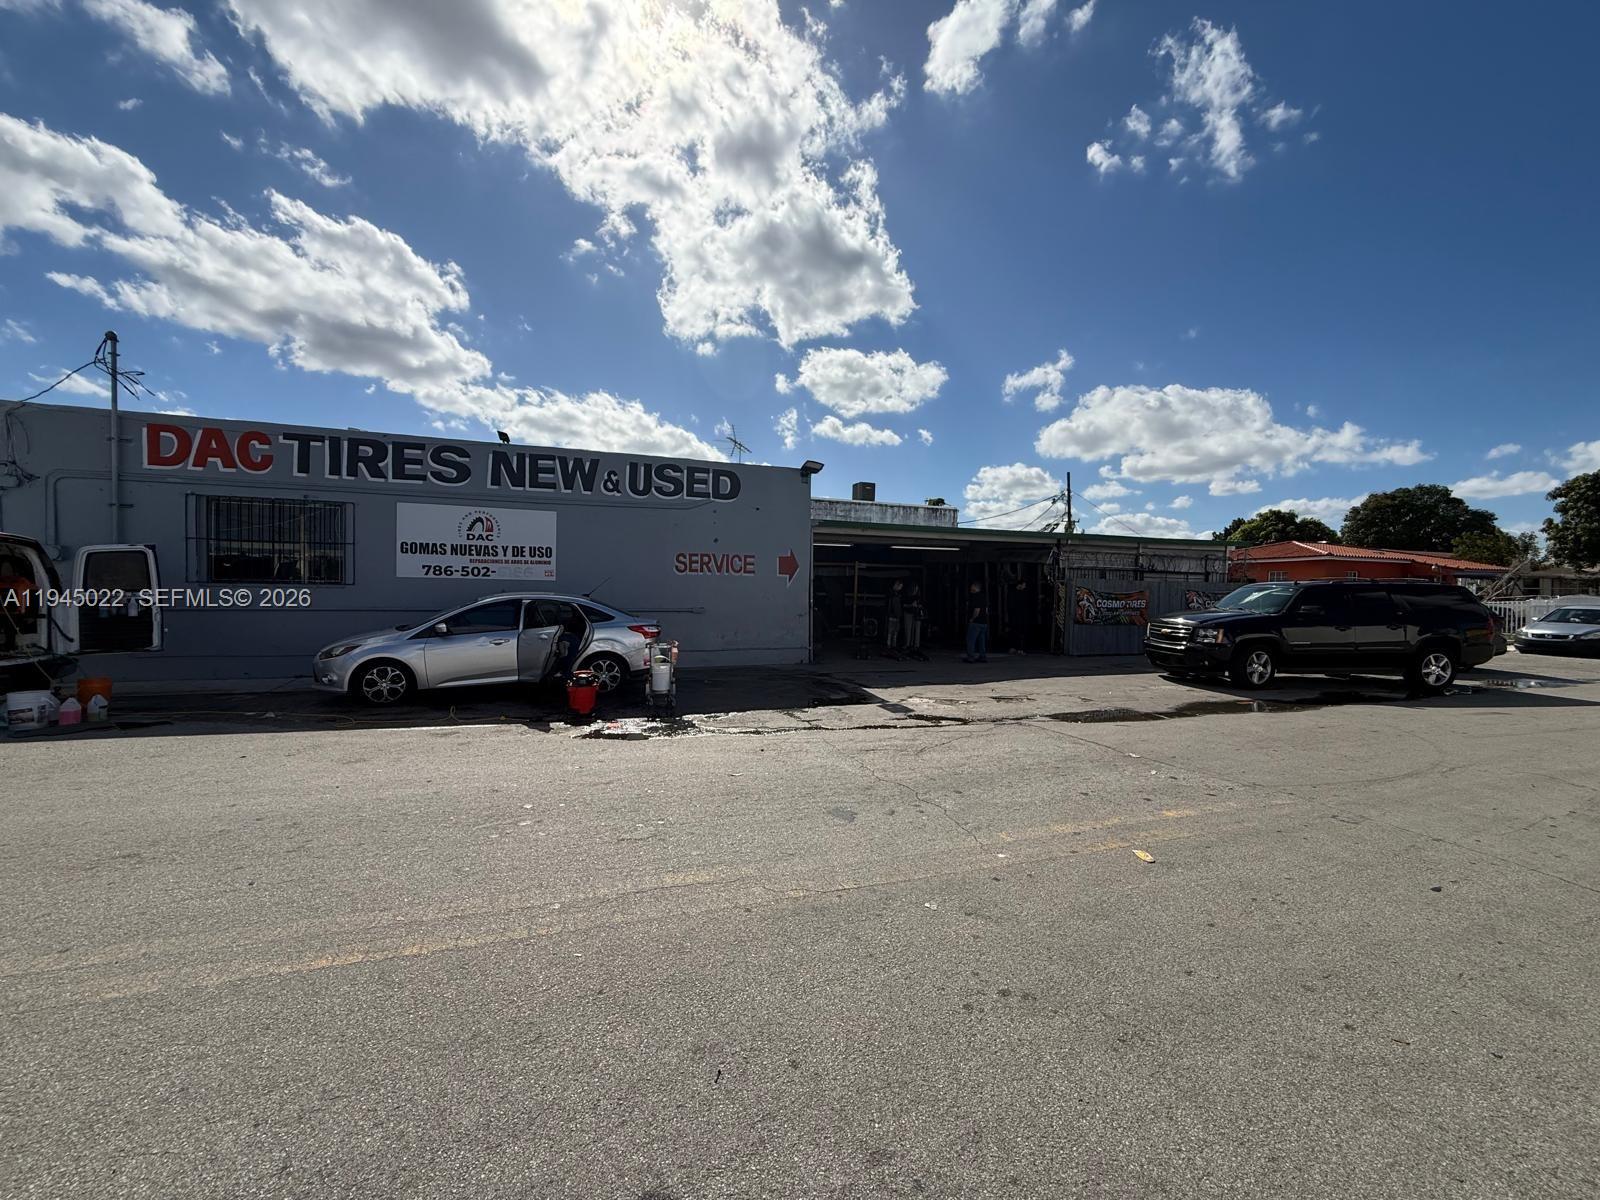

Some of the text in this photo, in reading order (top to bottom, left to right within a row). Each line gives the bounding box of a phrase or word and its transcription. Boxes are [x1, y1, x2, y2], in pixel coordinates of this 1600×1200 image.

[143, 423, 741, 502] DAC TIRES NEW & USED
[466, 533, 494, 542] DAC
[400, 541, 553, 558] GOMAS NUEVAS Y DE USO
[673, 552, 756, 577] SERVICE
[1096, 599, 1125, 608] COSMO
